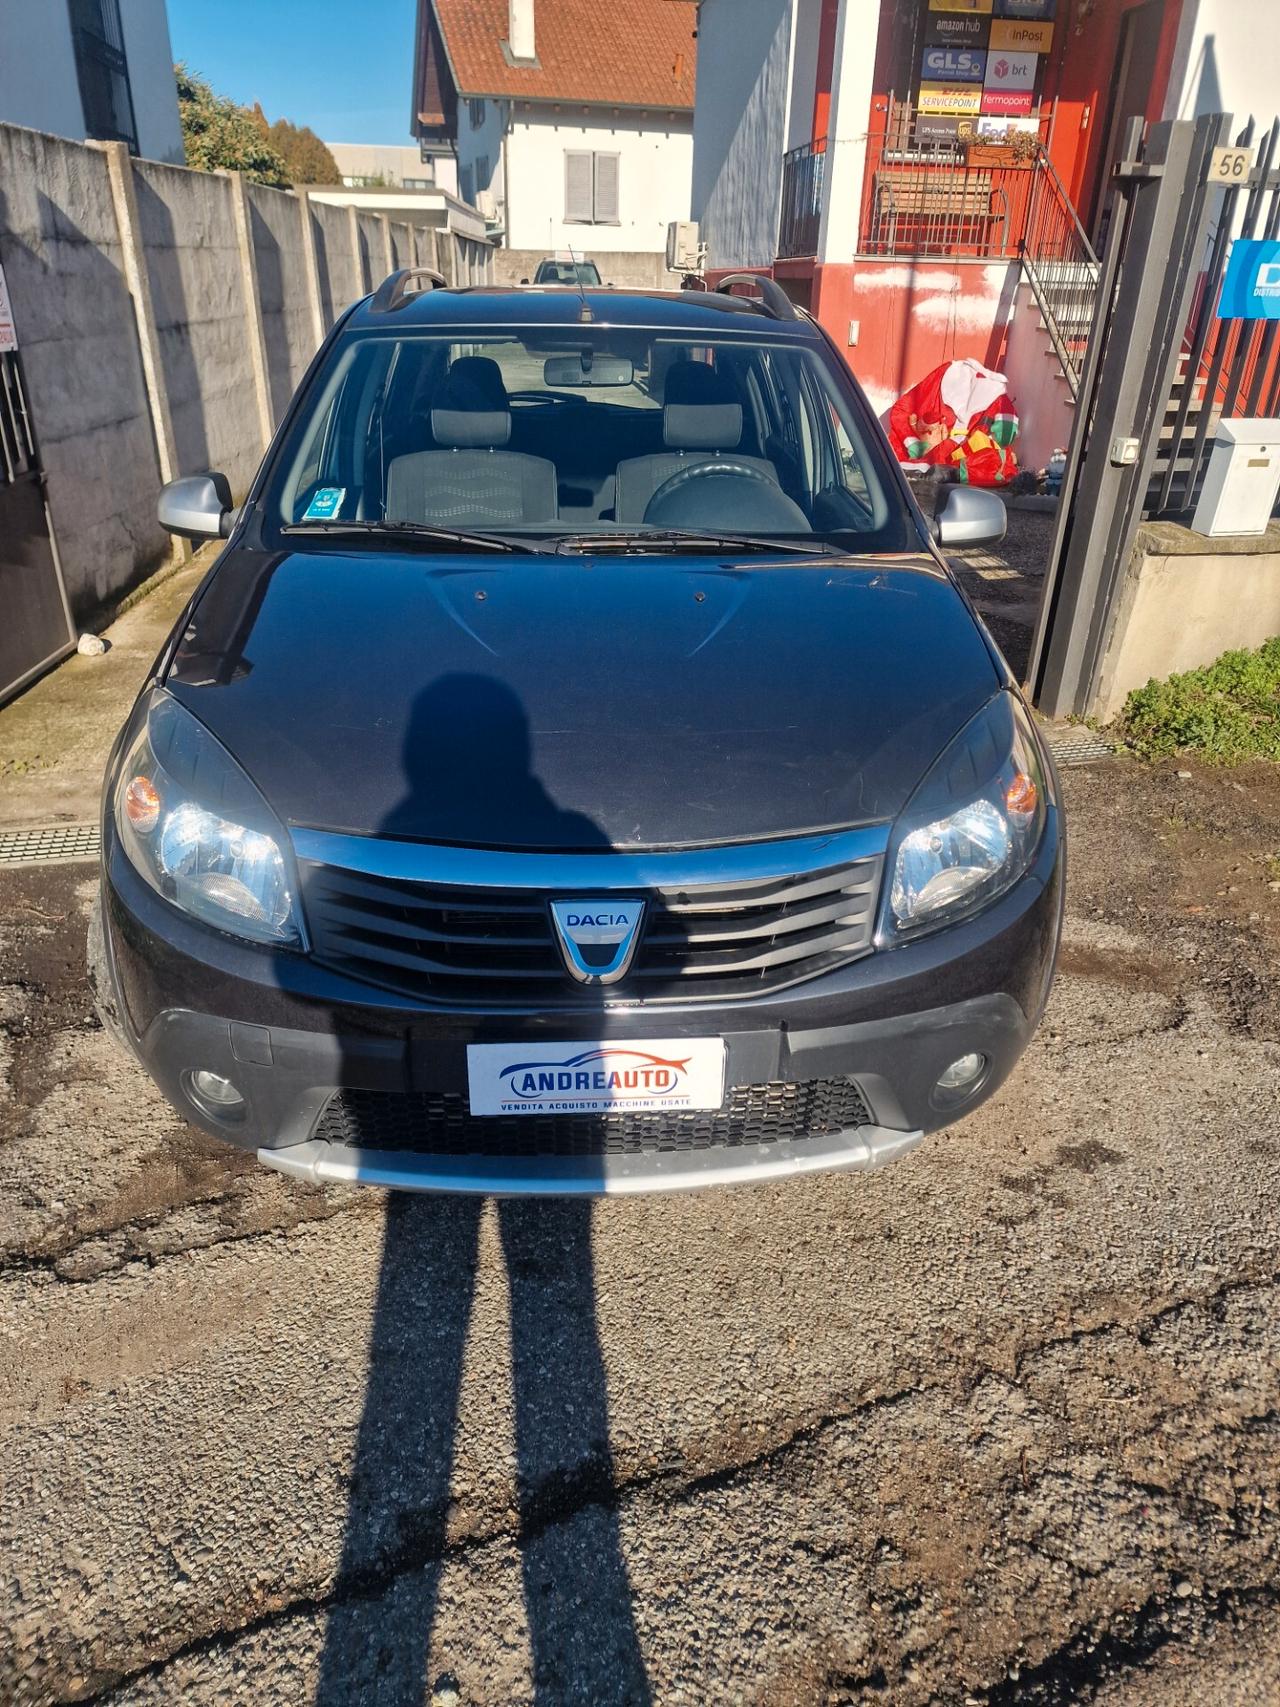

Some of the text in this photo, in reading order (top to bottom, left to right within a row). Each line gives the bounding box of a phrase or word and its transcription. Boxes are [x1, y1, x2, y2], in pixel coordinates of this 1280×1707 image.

[936, 18, 981, 32] amazon hub
[1011, 63, 1028, 76] brt
[942, 87, 972, 97] DHL
[922, 97, 977, 108] SERVICEPOINT
[983, 94, 1031, 107] fermopoint
[1219, 154, 1245, 177] 56
[566, 914, 629, 927] DACIA
[521, 1070, 670, 1092] ANDREAUTO
[603, 1100, 656, 1108] MACCHINE
